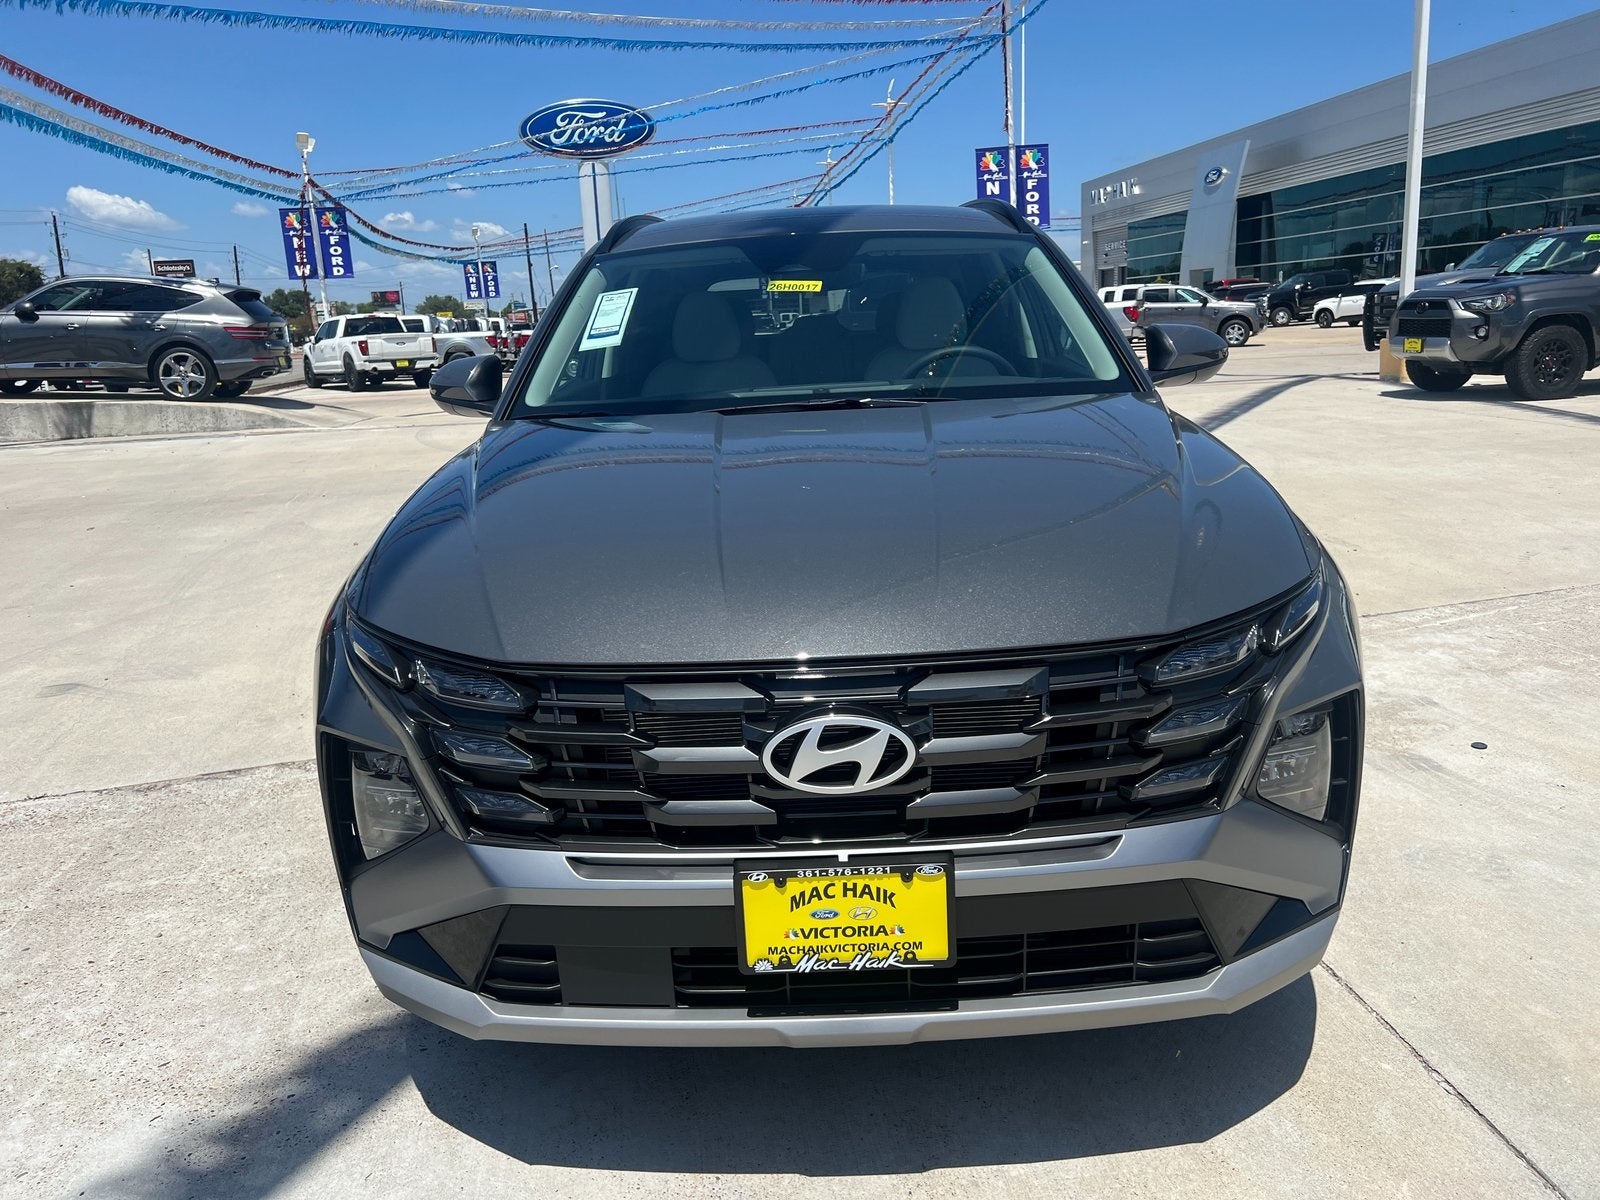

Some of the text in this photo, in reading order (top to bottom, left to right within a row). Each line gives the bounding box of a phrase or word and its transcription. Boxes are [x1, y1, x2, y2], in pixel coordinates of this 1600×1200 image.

[550, 111, 627, 144] Ford
[1025, 179, 1040, 226] FORD
[1104, 240, 1127, 251] SERVICE
[329, 235, 345, 276] FORD
[469, 276, 479, 298] NEW
[487, 275, 496, 297] FORD
[769, 283, 819, 291] 26H0017
[796, 866, 891, 878] 361-576-1221
[920, 864, 939, 874] Ford
[790, 882, 897, 913] MAC HAIK
[814, 909, 836, 919] Ford
[800, 925, 889, 940] VICTORIA
[767, 941, 923, 956] MACHAIKVICTORIA.COM
[793, 951, 909, 973] Mac Haik
